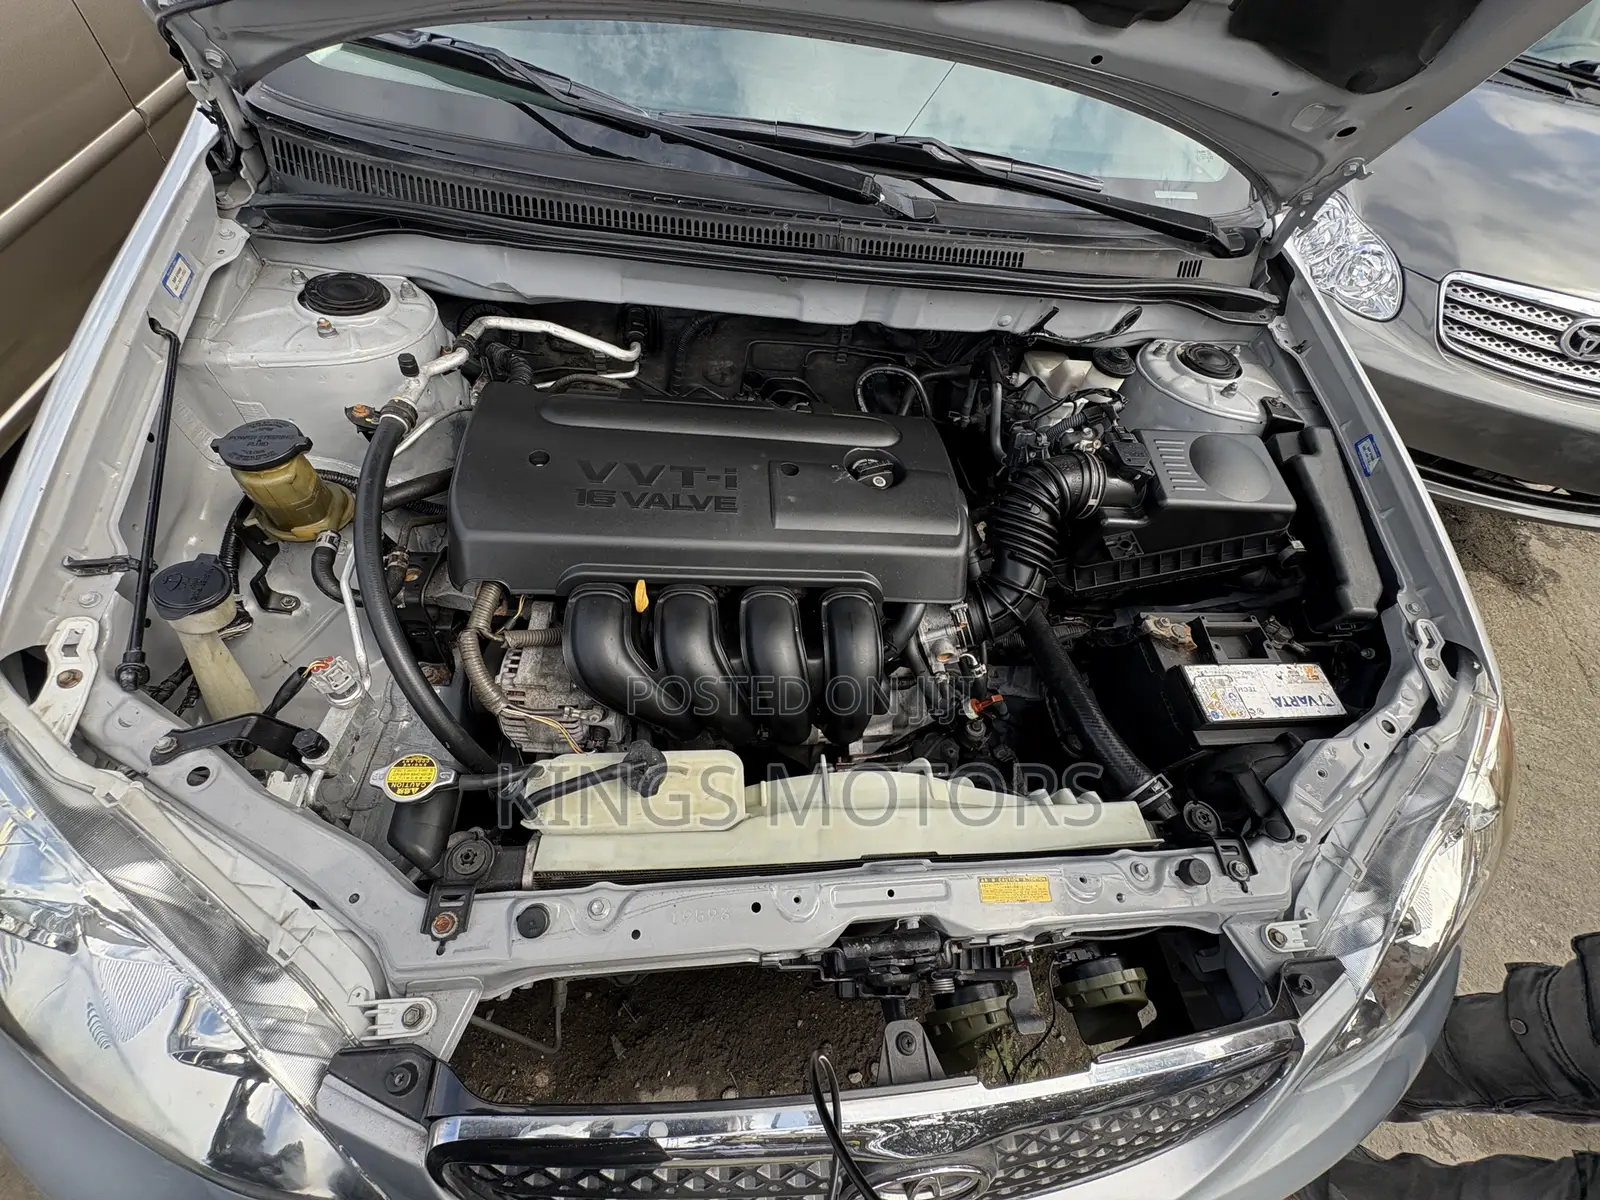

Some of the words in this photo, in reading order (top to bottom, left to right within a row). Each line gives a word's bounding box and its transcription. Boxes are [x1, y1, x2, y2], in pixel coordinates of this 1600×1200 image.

[576, 459, 738, 490] VVT-i
[575, 488, 617, 508] 16
[621, 491, 739, 515] VALVE
[1271, 694, 1317, 708] VARTA
